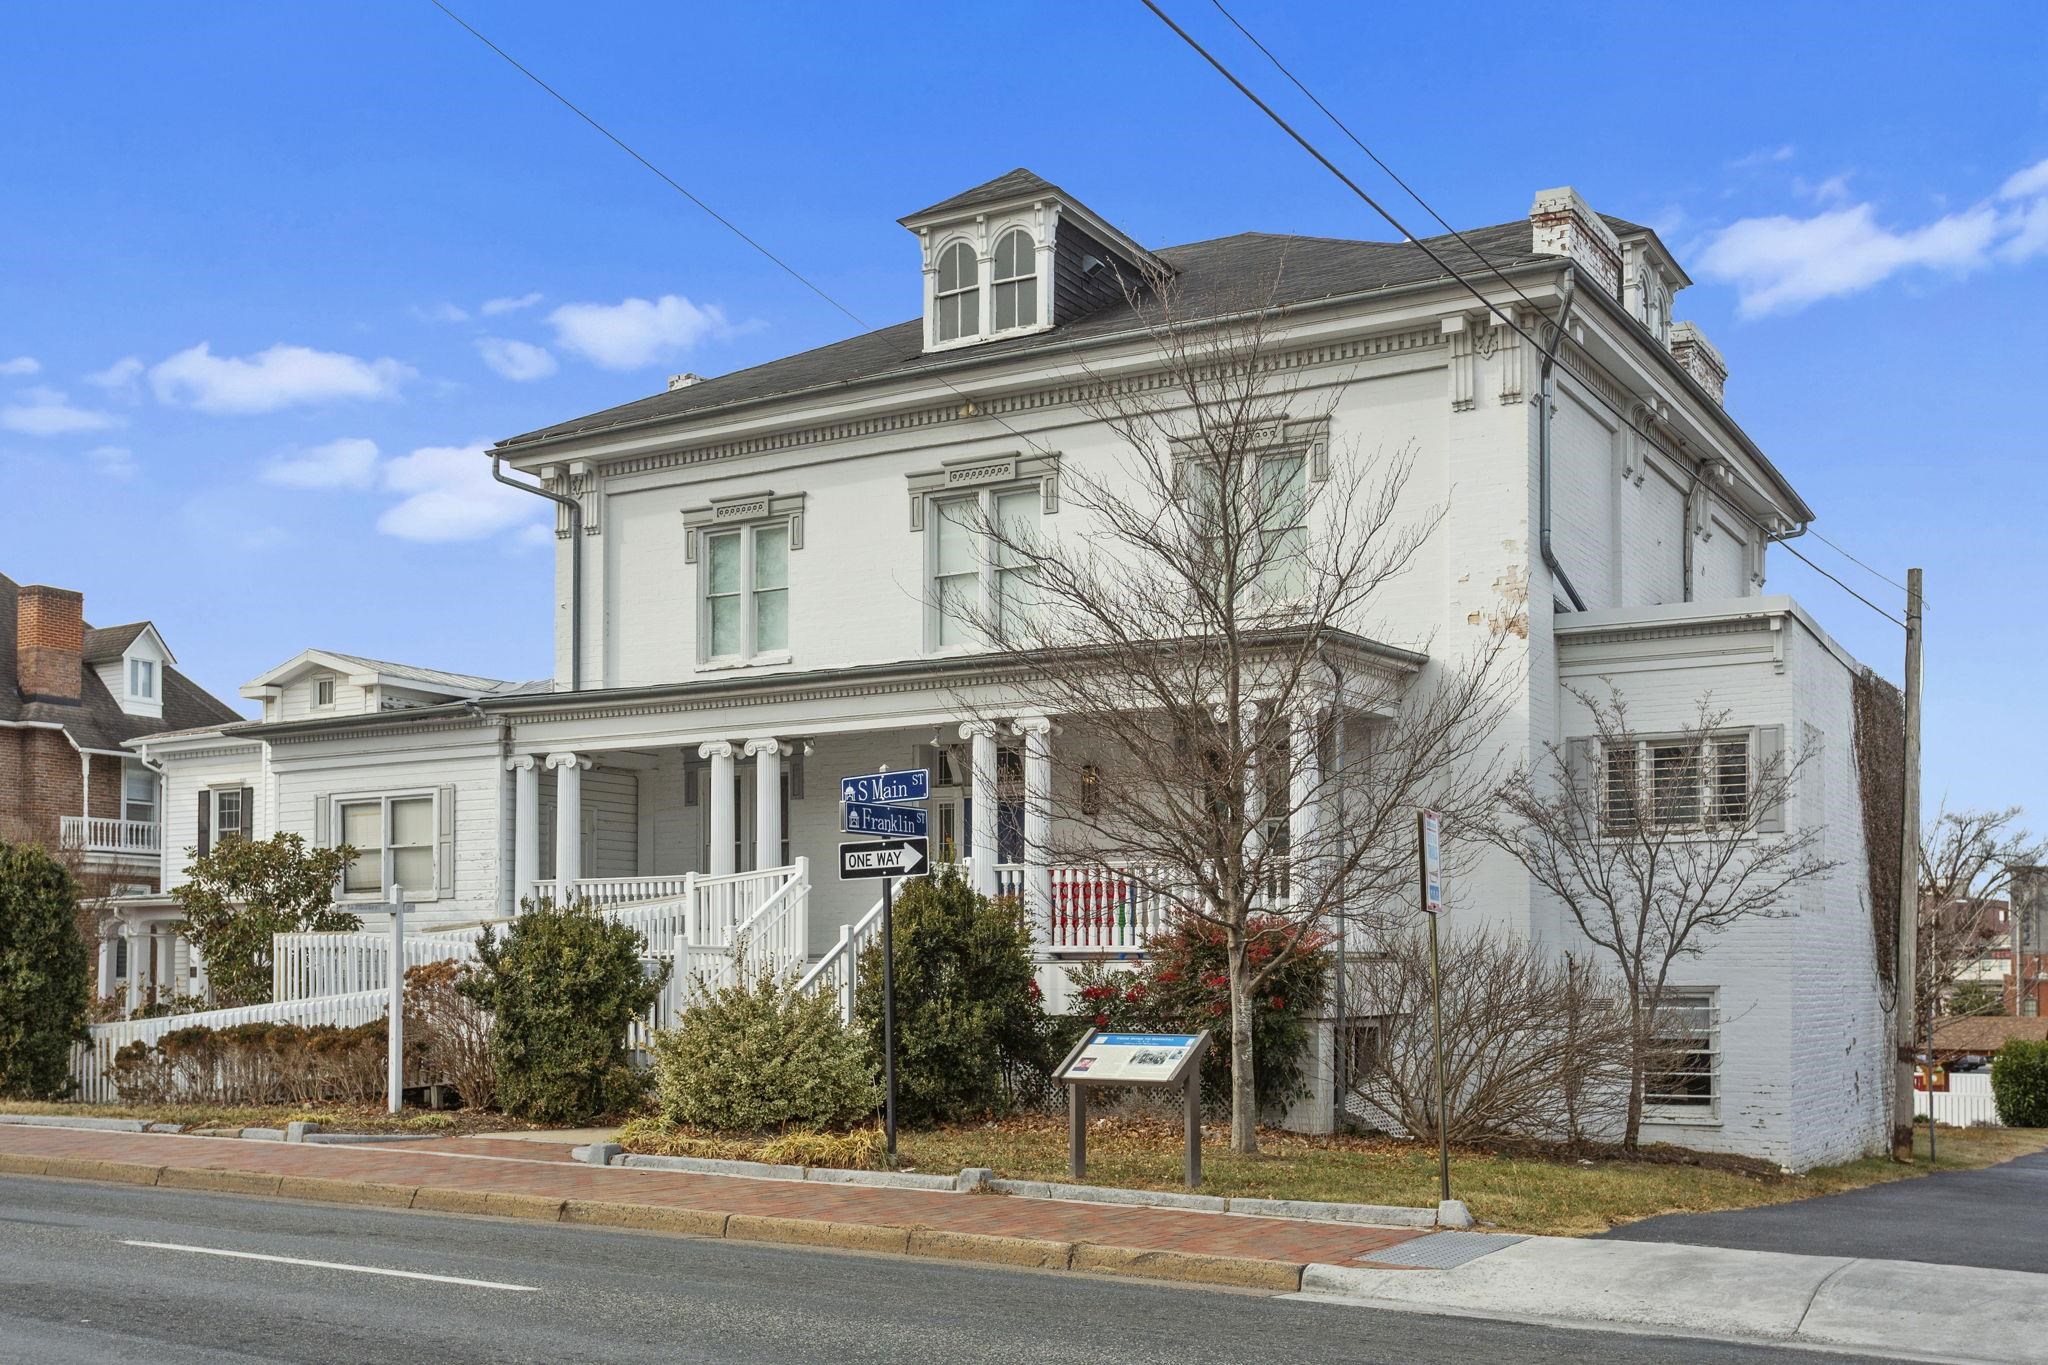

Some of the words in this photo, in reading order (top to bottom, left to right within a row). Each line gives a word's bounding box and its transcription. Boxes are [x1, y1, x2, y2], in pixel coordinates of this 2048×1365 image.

[859, 780, 868, 800] S
[872, 779, 908, 800] Main
[912, 773, 924, 785] ST
[862, 808, 915, 833] Franklin
[916, 812, 926, 823] ST
[848, 853, 872, 868] ONE
[876, 851, 902, 866] WAY
